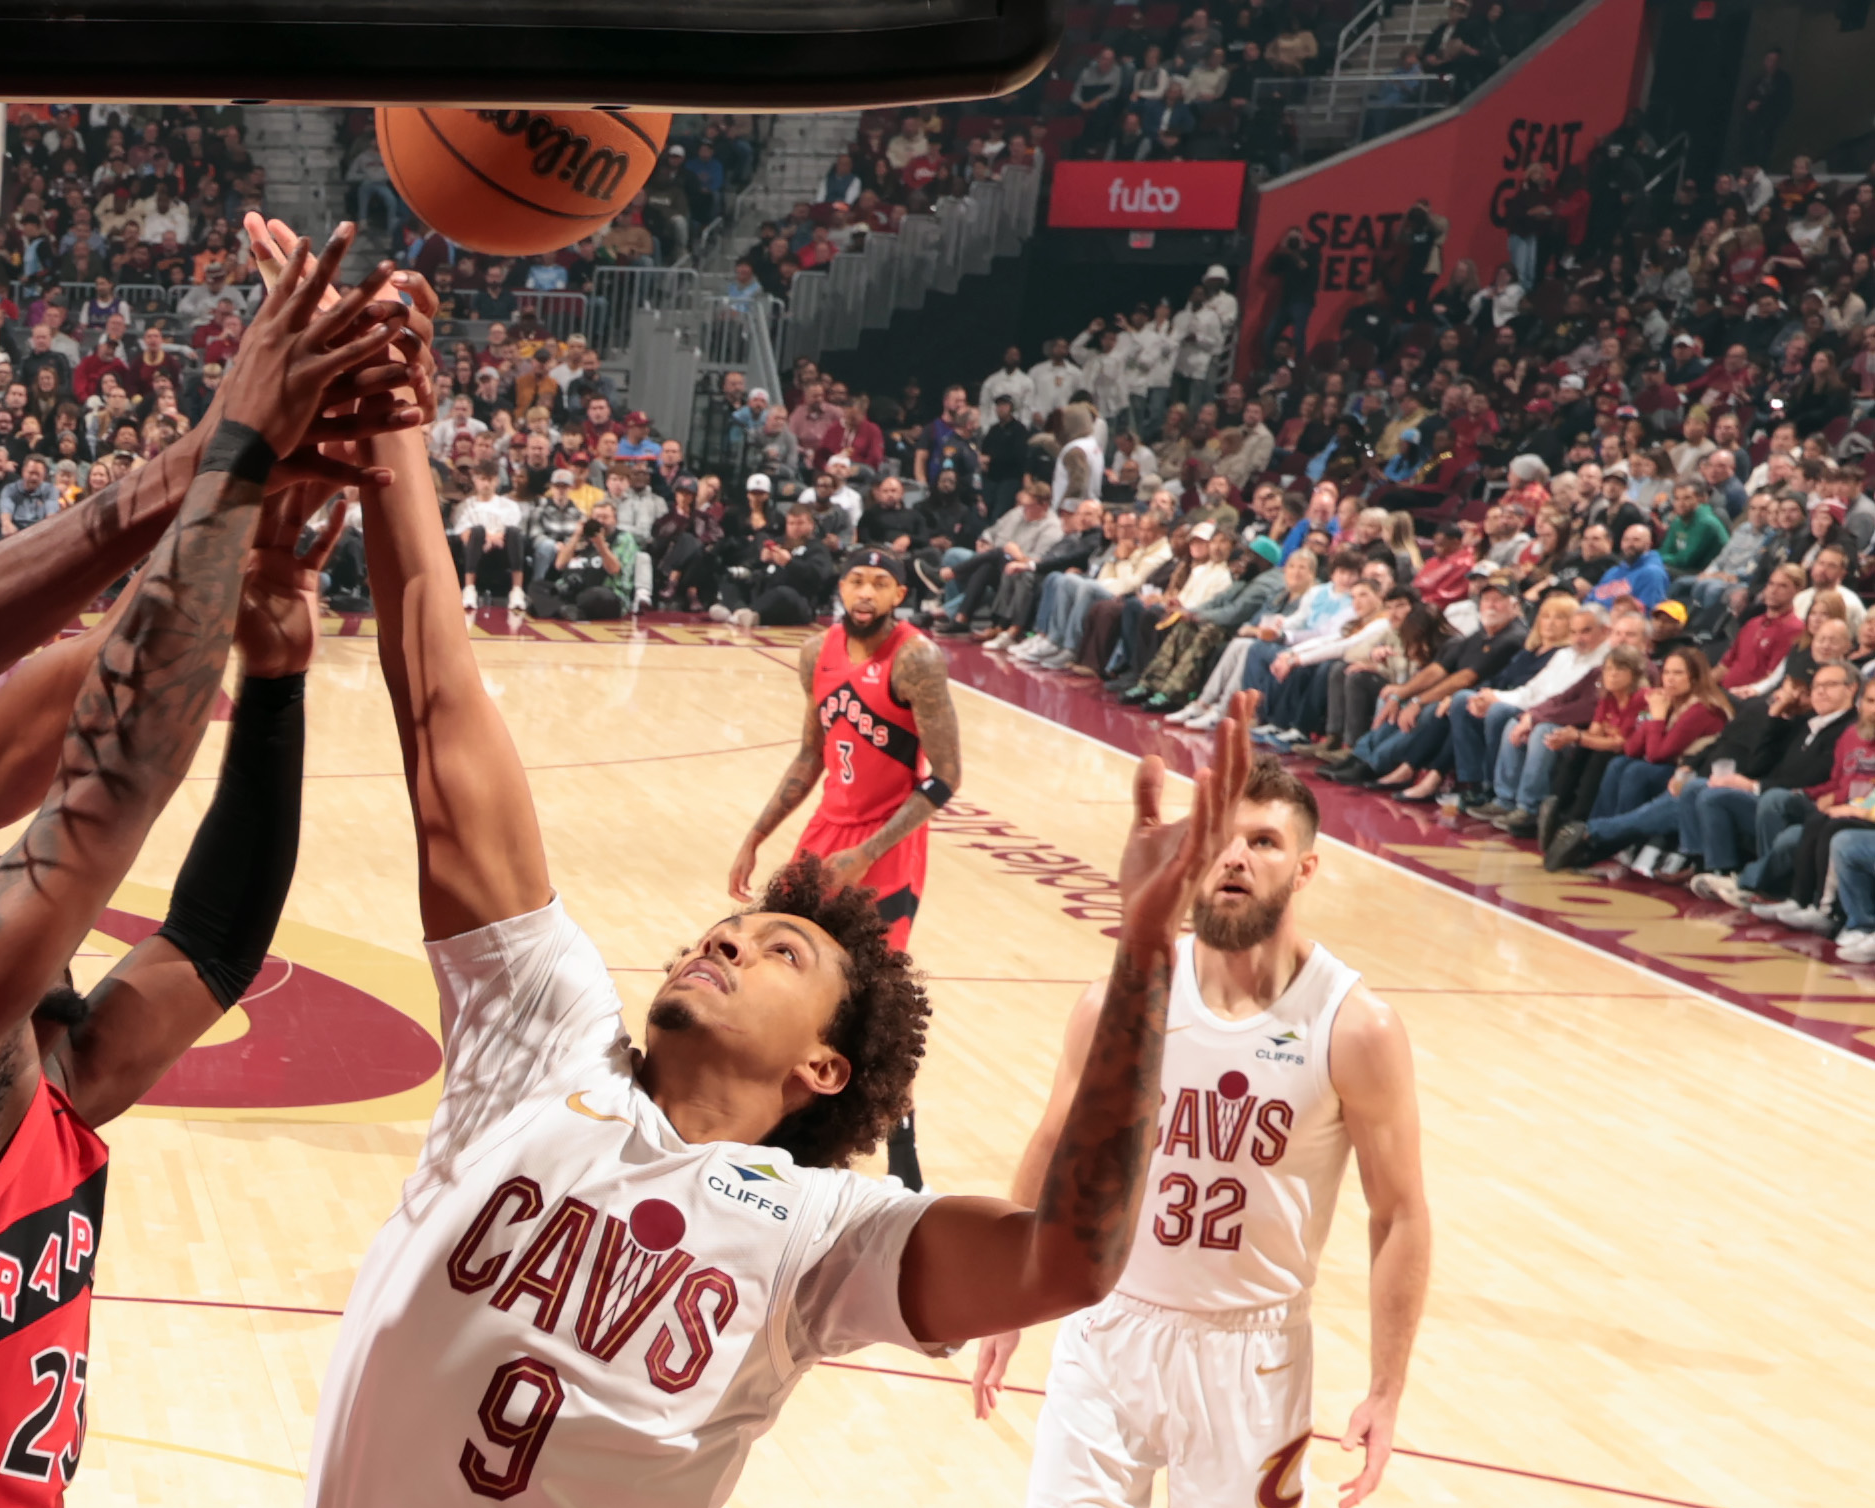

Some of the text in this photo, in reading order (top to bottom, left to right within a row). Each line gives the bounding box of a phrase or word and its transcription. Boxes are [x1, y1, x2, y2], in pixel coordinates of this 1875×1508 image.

[478, 110, 629, 202] Wilso
[1109, 178, 1180, 212] fubo
[1307, 212, 1403, 250] SEAT
[836, 740, 855, 784] 3
[1255, 1048, 1305, 1065] CLIFFS
[1153, 1085, 1295, 1167] AVS
[706, 1173, 791, 1222] CLIFFS
[1153, 1172, 1247, 1252] 32
[446, 1174, 741, 1396] CAVS
[0, 1345, 88, 1487] 23
[458, 1356, 566, 1502] 9
